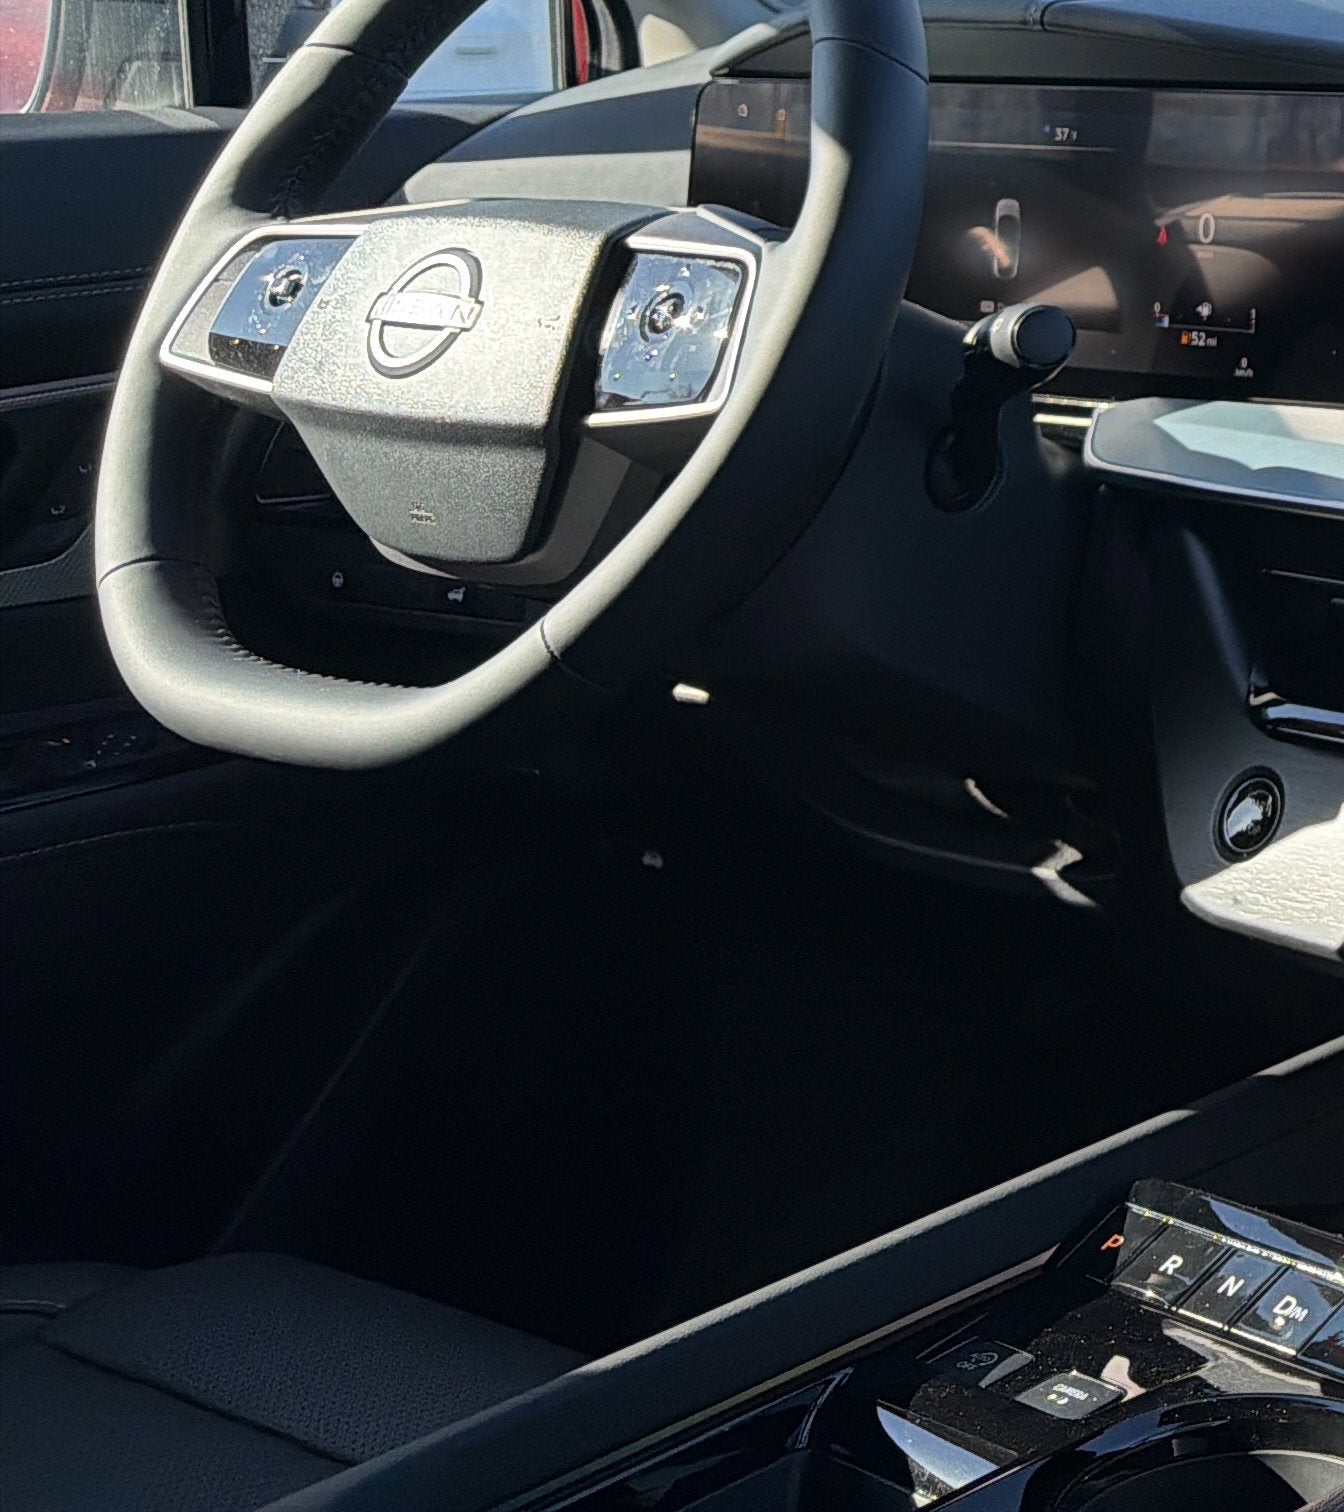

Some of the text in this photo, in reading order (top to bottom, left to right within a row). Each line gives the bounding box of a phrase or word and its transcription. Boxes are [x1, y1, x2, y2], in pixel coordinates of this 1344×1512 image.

[1199, 212, 1215, 244] 0
[1100, 1234, 1125, 1251] P
[1158, 1254, 1184, 1275] R
[1217, 1275, 1245, 1298] N
